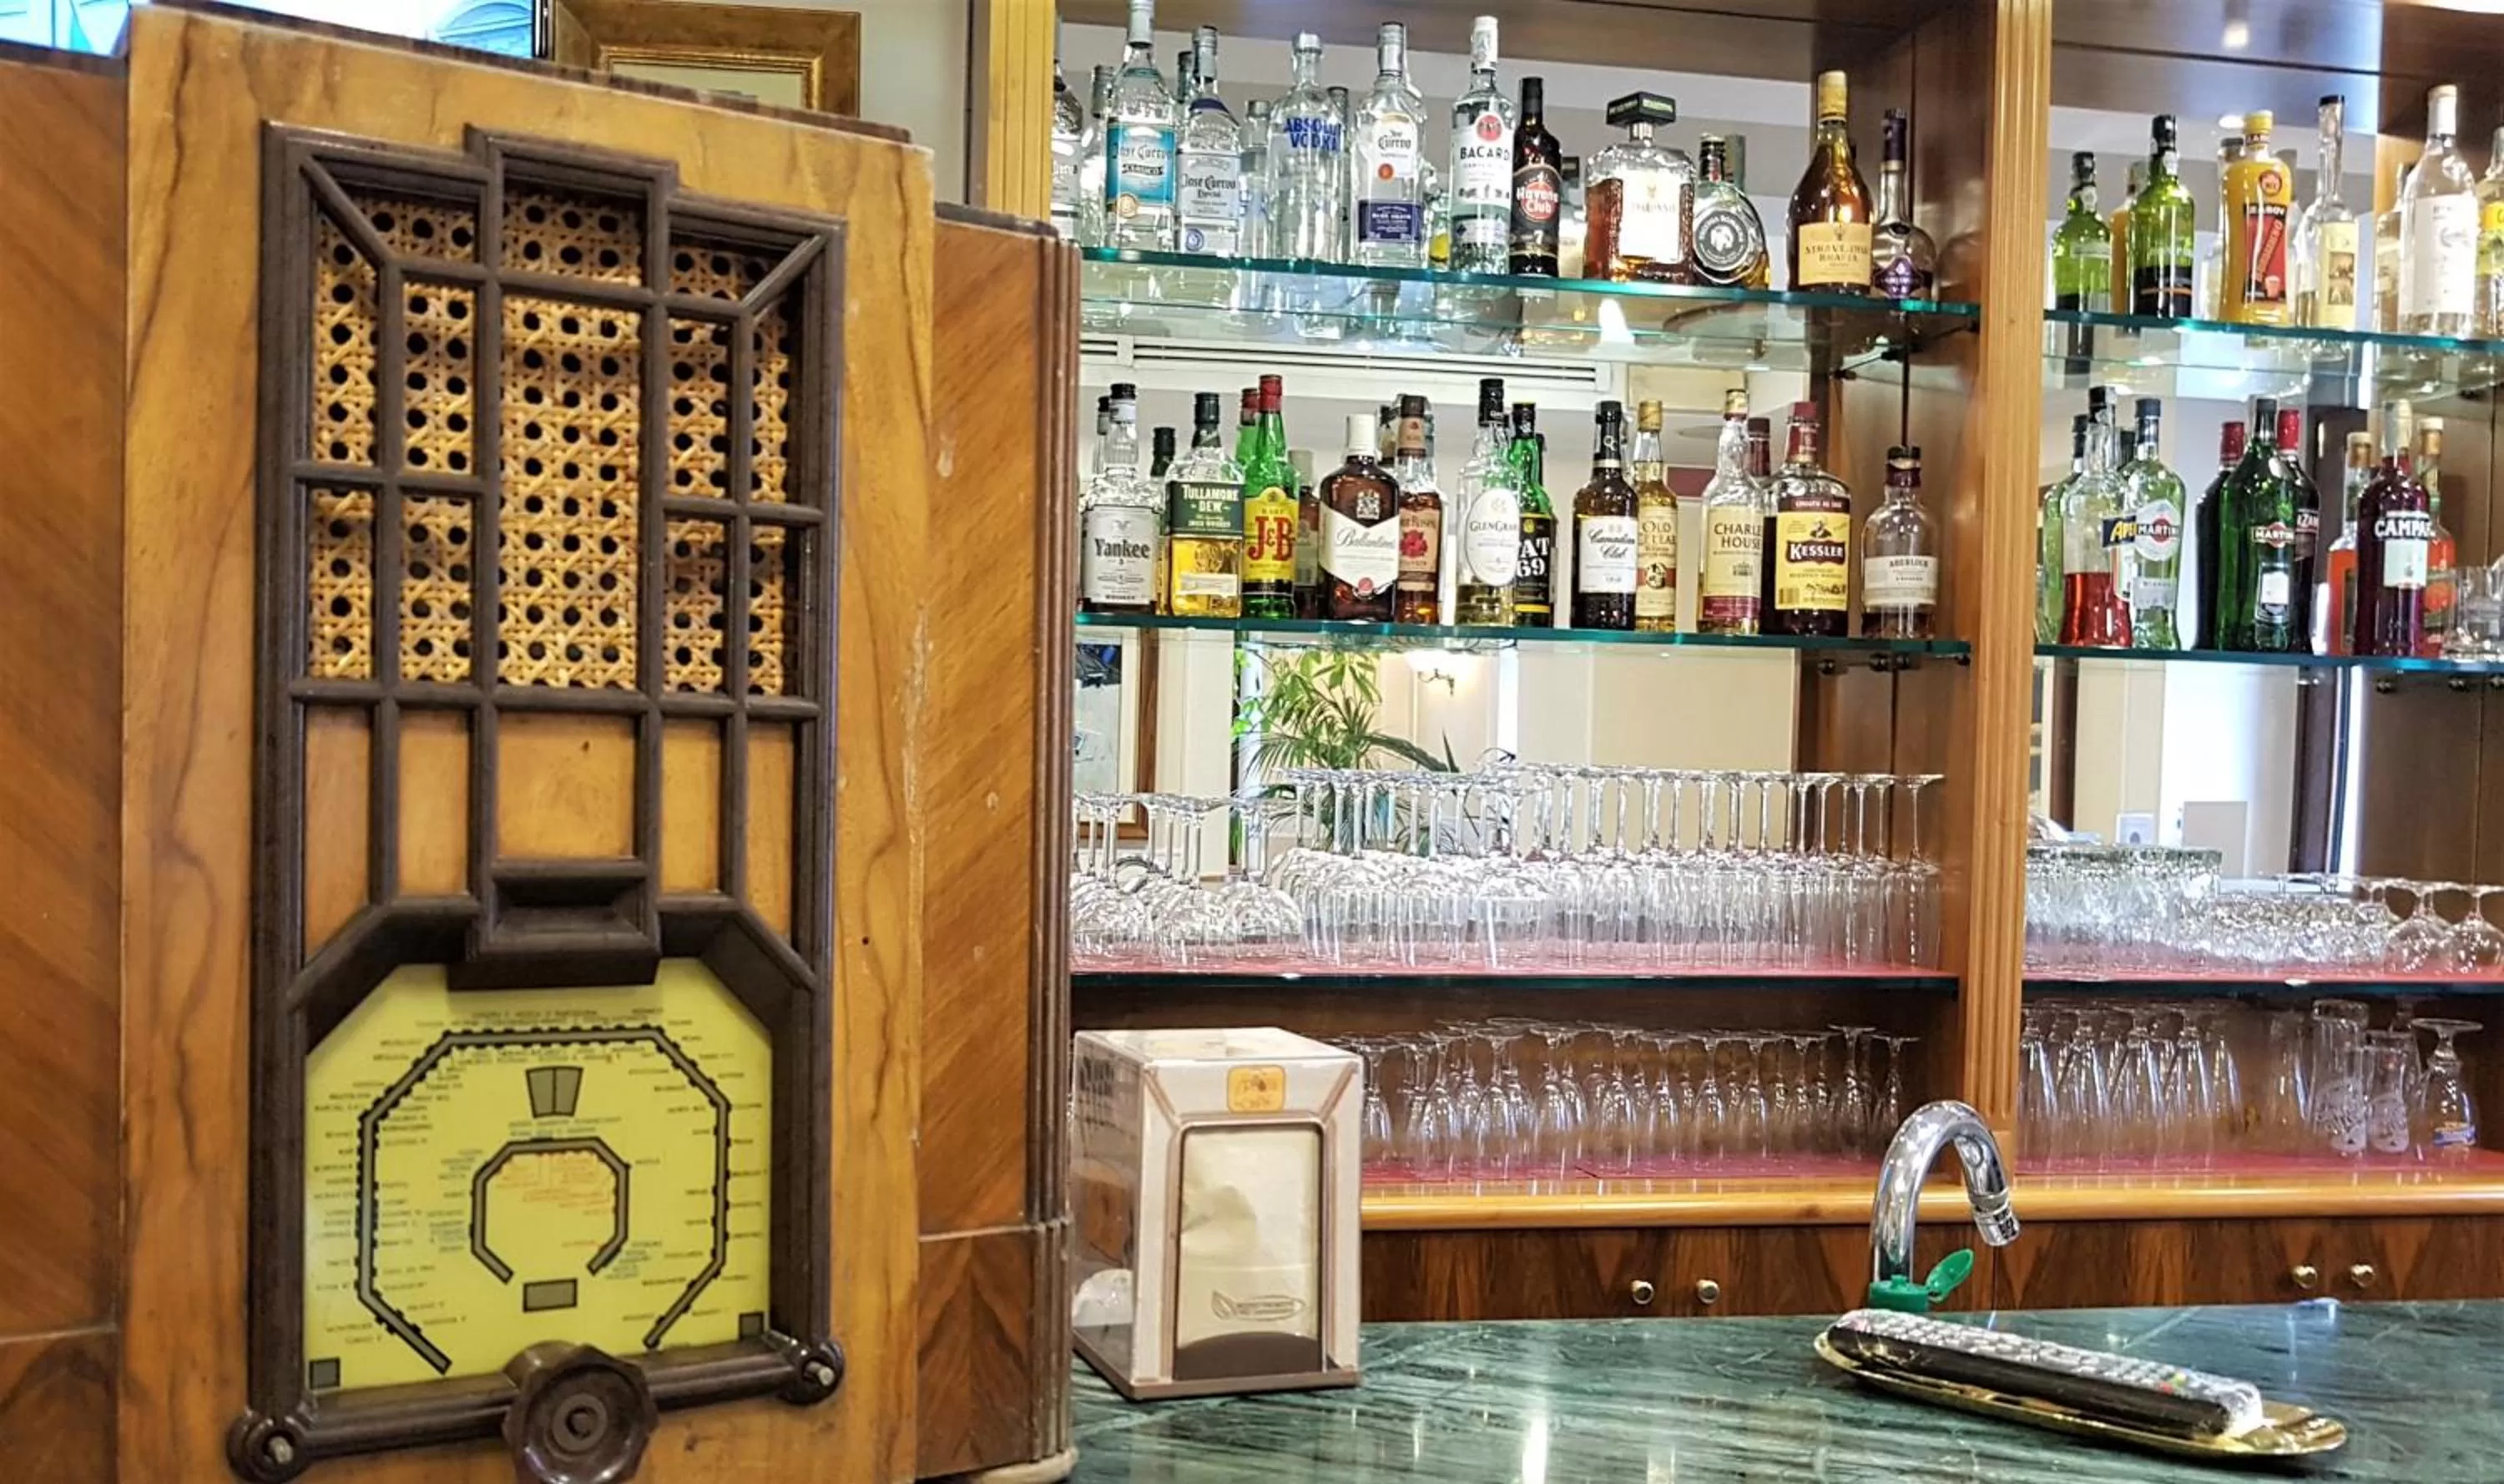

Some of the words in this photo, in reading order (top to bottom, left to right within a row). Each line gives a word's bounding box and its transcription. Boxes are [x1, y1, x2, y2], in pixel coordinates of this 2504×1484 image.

[1460, 146, 1511, 161] BACARD
[1182, 483, 1240, 502] TULLAMORE
[1713, 522, 1761, 536] CHARLE
[2254, 529, 2294, 541] MARTIN
[1094, 538, 1151, 559] Yankee
[1521, 537, 1550, 558] AT
[1789, 543, 1844, 560] KESSLER
[1517, 558, 1545, 578] 69
